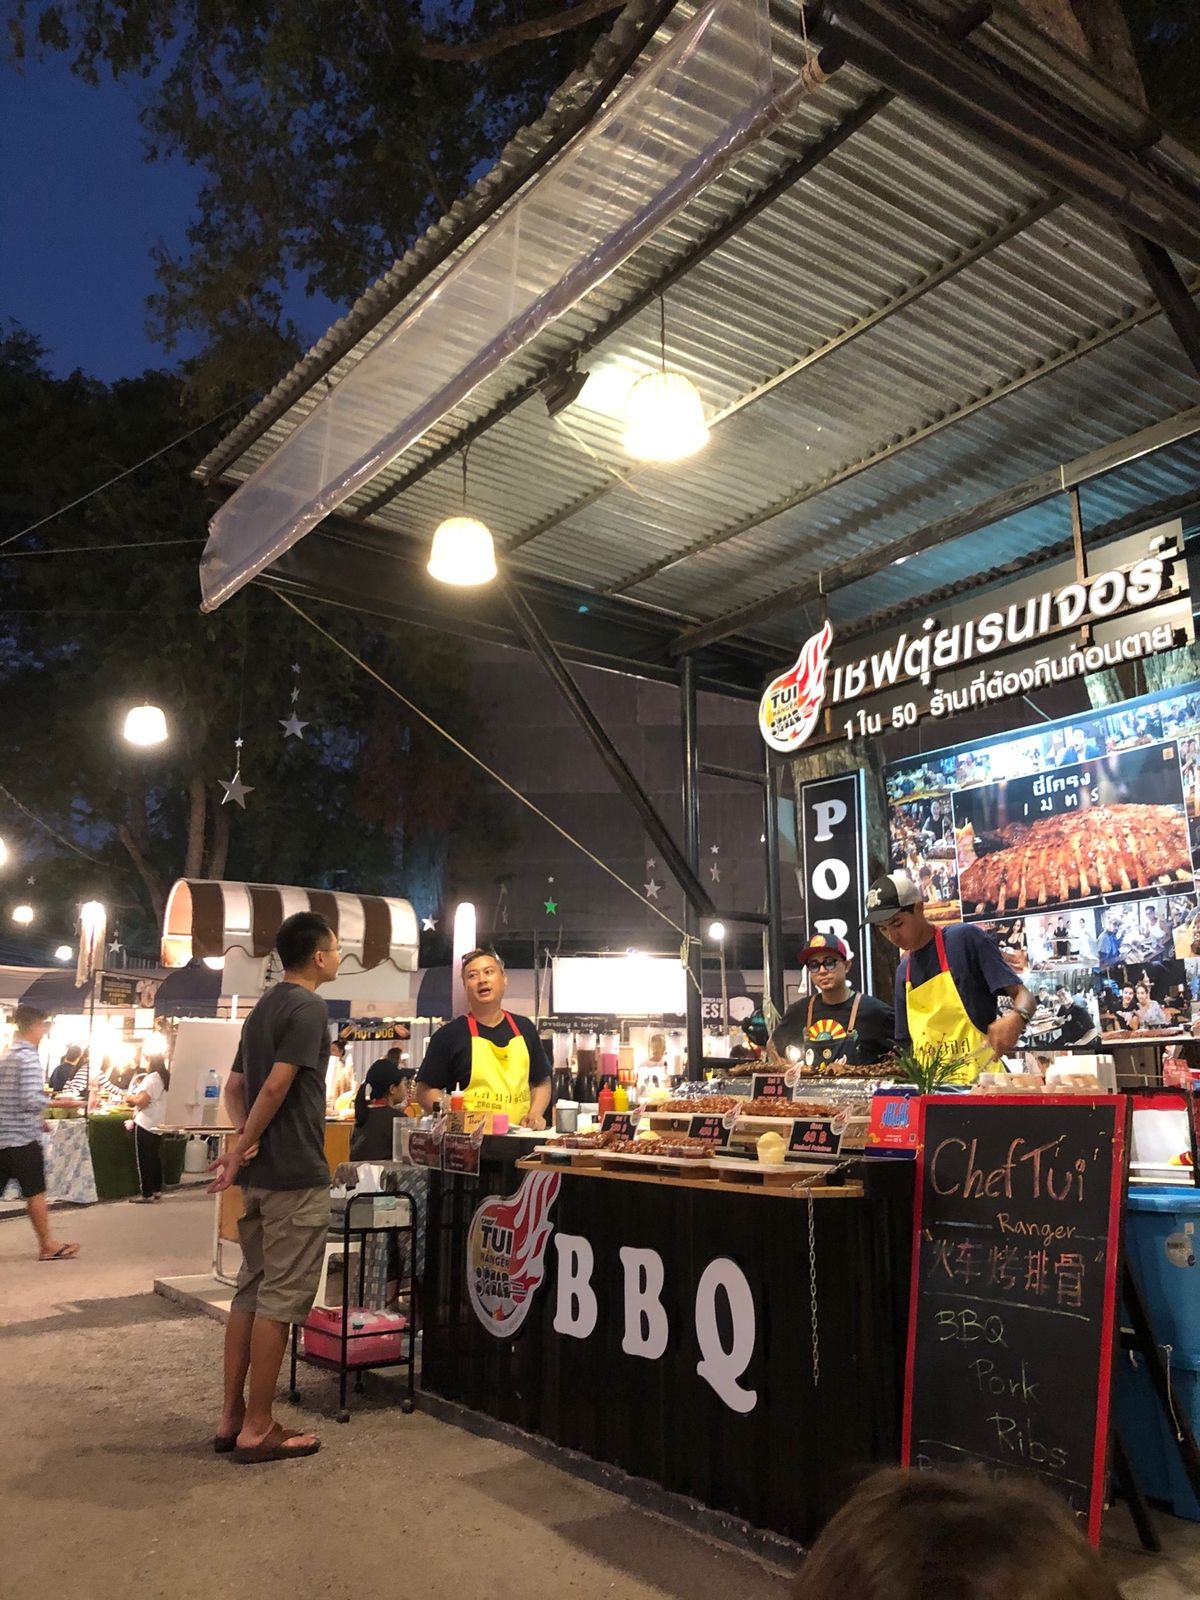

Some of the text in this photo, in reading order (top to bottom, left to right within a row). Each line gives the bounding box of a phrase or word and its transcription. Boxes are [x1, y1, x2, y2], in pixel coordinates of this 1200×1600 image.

[833, 535, 1178, 702] เชฟตุ๋ยเรนเจอร์
[771, 685, 798, 709] TUI
[844, 720, 852, 740] 1
[859, 710, 881, 736] ใน
[892, 702, 918, 728] 50
[931, 1137, 1084, 1201] Chef Tui
[481, 1227, 513, 1255] TUI
[997, 1213, 1076, 1247] Ranger
[480, 1252, 510, 1268] RANGER
[553, 1232, 758, 1413] BBQ
[935, 1309, 1009, 1349] BBQ
[968, 1358, 1040, 1403] Pork
[986, 1412, 1069, 1469] Ribs
